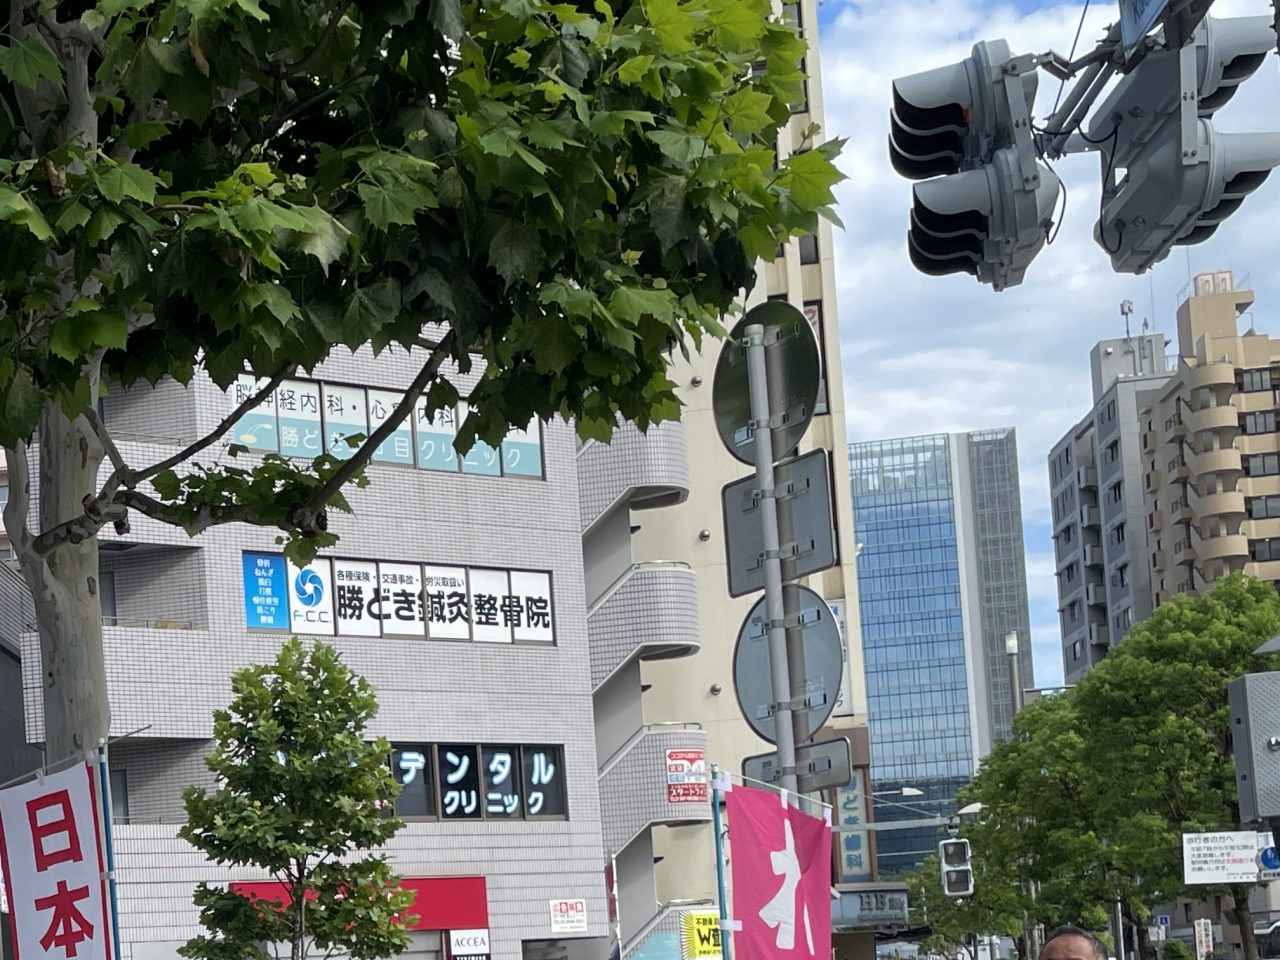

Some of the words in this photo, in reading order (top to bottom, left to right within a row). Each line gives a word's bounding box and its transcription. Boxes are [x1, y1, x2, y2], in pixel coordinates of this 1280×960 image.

[337, 585, 550, 629] 勝どき鍼灸整骨院
[444, 790, 544, 815] クリニック
[455, 937, 486, 947] ACCEA
